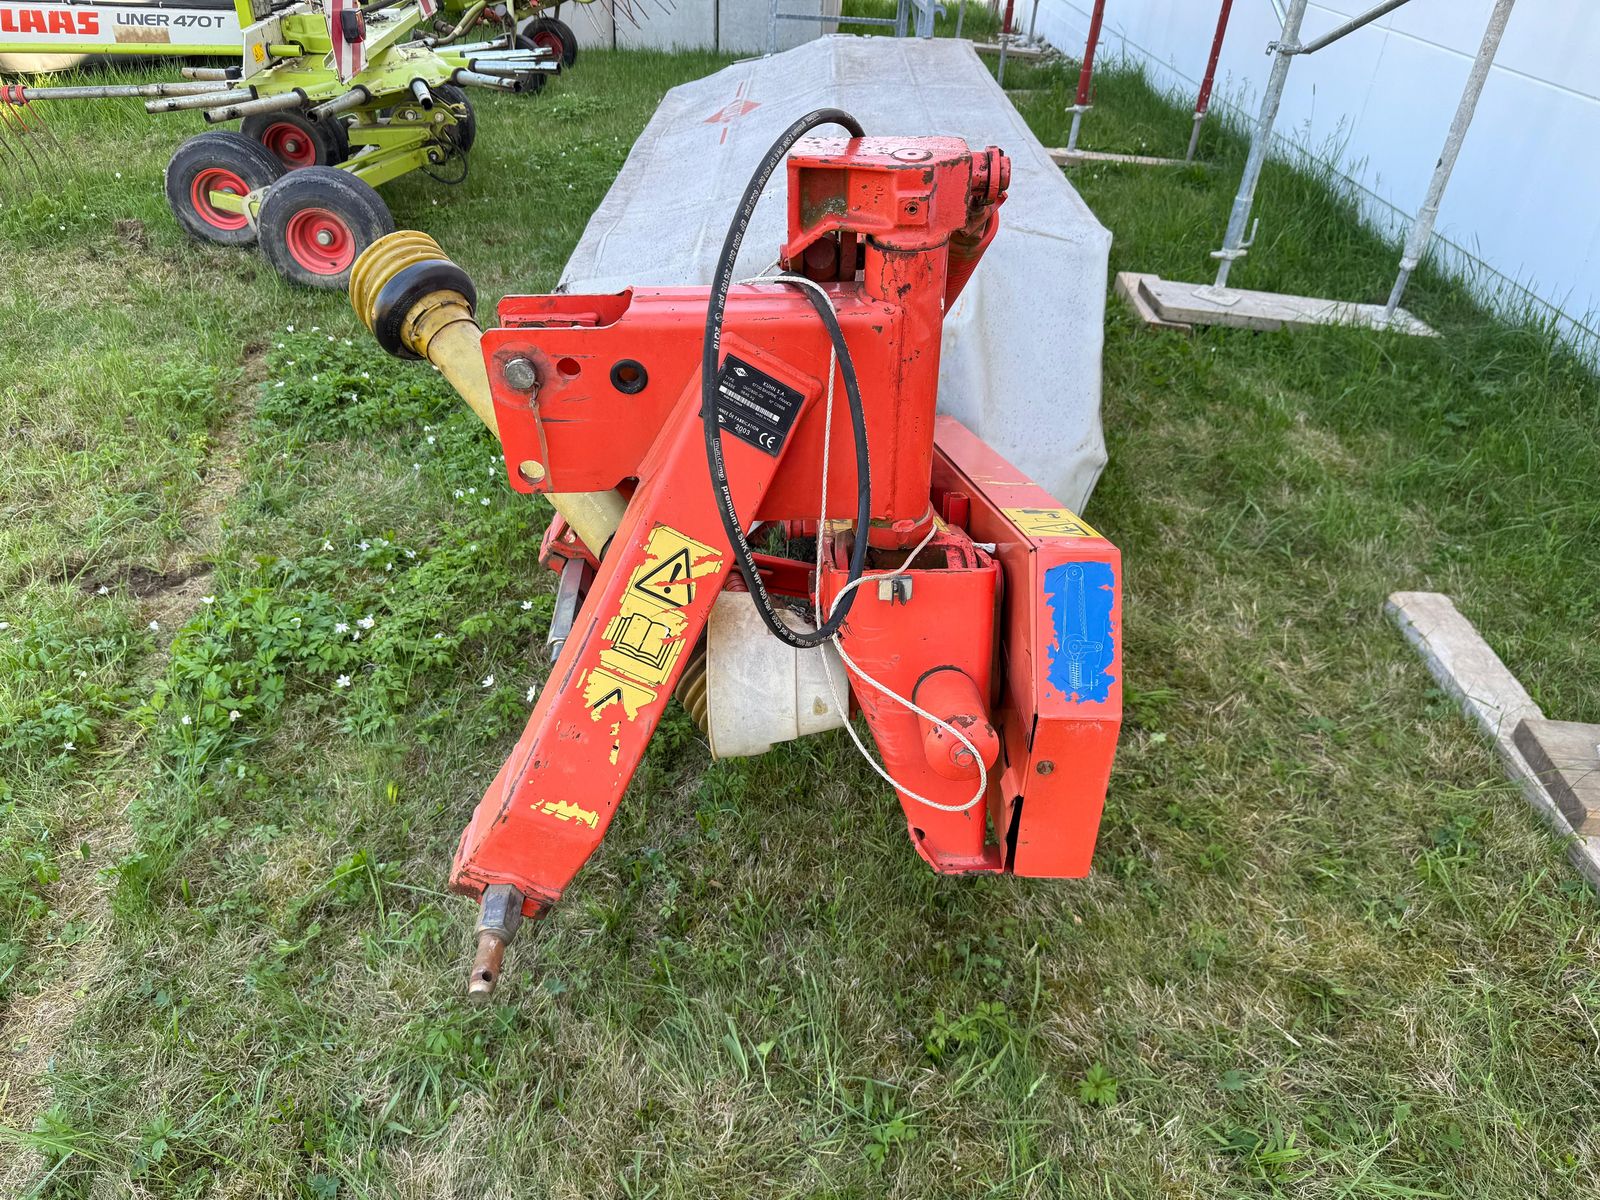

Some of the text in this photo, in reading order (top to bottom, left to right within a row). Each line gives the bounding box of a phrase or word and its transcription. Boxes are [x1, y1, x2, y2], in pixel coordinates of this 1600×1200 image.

[0, 9, 99, 35] LAAS
[116, 13, 169, 26] LINER
[744, 204, 752, 218] psi
[733, 231, 742, 250] 1800
[735, 423, 751, 436] 2003
[759, 433, 775, 449] CE
[721, 485, 738, 526] premium
[745, 552, 754, 566] DN
[753, 572, 762, 585] WP
[759, 586, 768, 600] 450
[764, 598, 772, 612] bar
